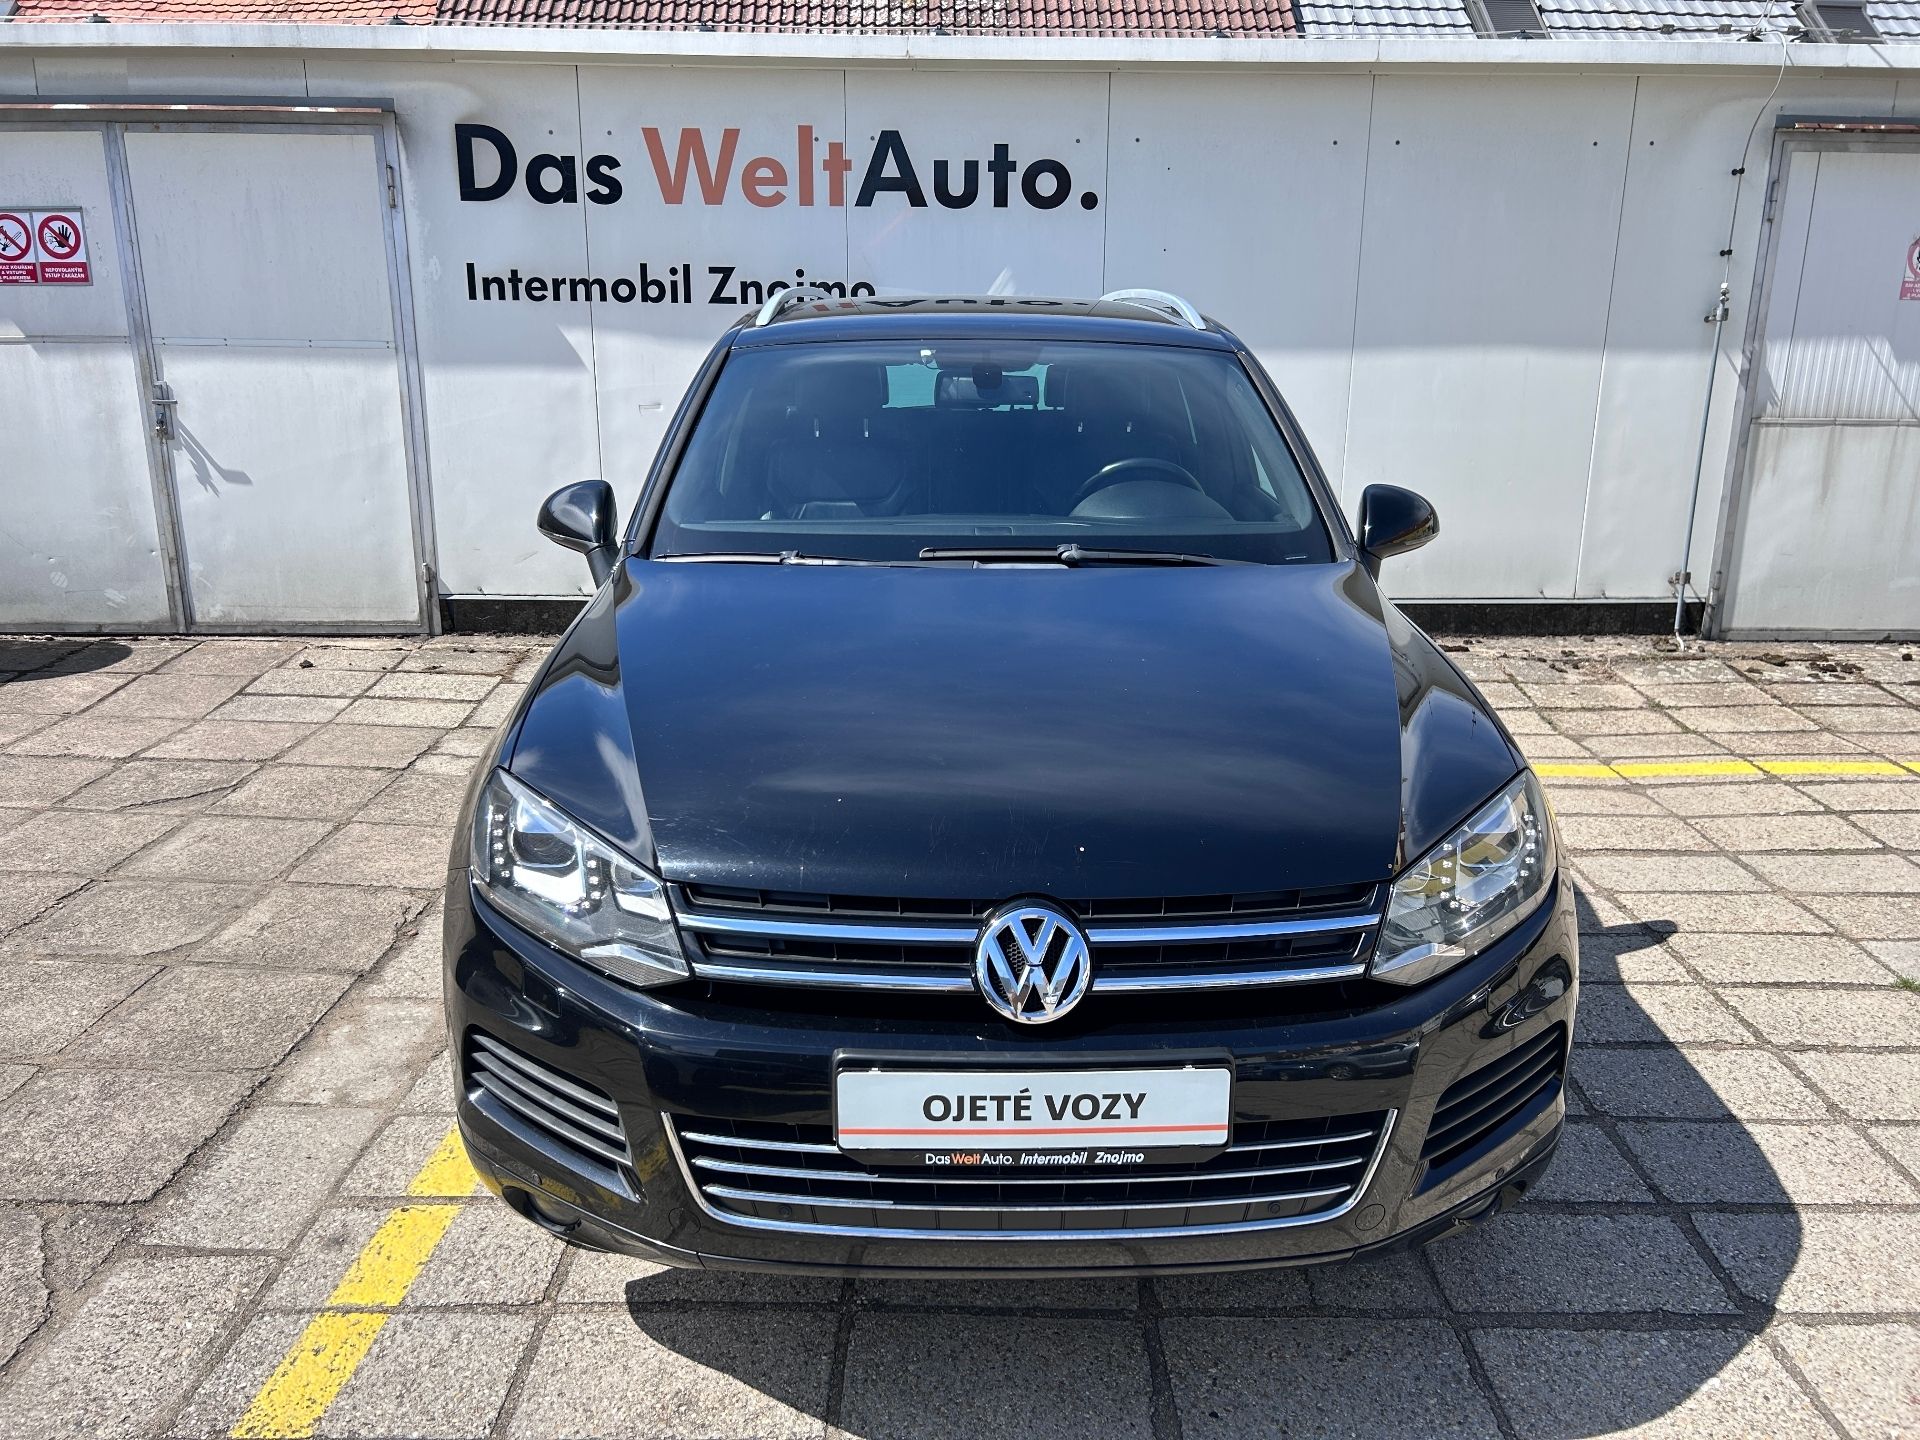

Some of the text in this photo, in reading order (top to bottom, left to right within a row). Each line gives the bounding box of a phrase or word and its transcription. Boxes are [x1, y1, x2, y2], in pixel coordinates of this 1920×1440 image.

[455, 123, 623, 205] Das
[466, 262, 693, 304] Intermobil
[922, 1088, 1148, 1122] OJETÉ VOZY
[1020, 1152, 1088, 1165] Intermobil
[1094, 1151, 1145, 1165] Znojmo
